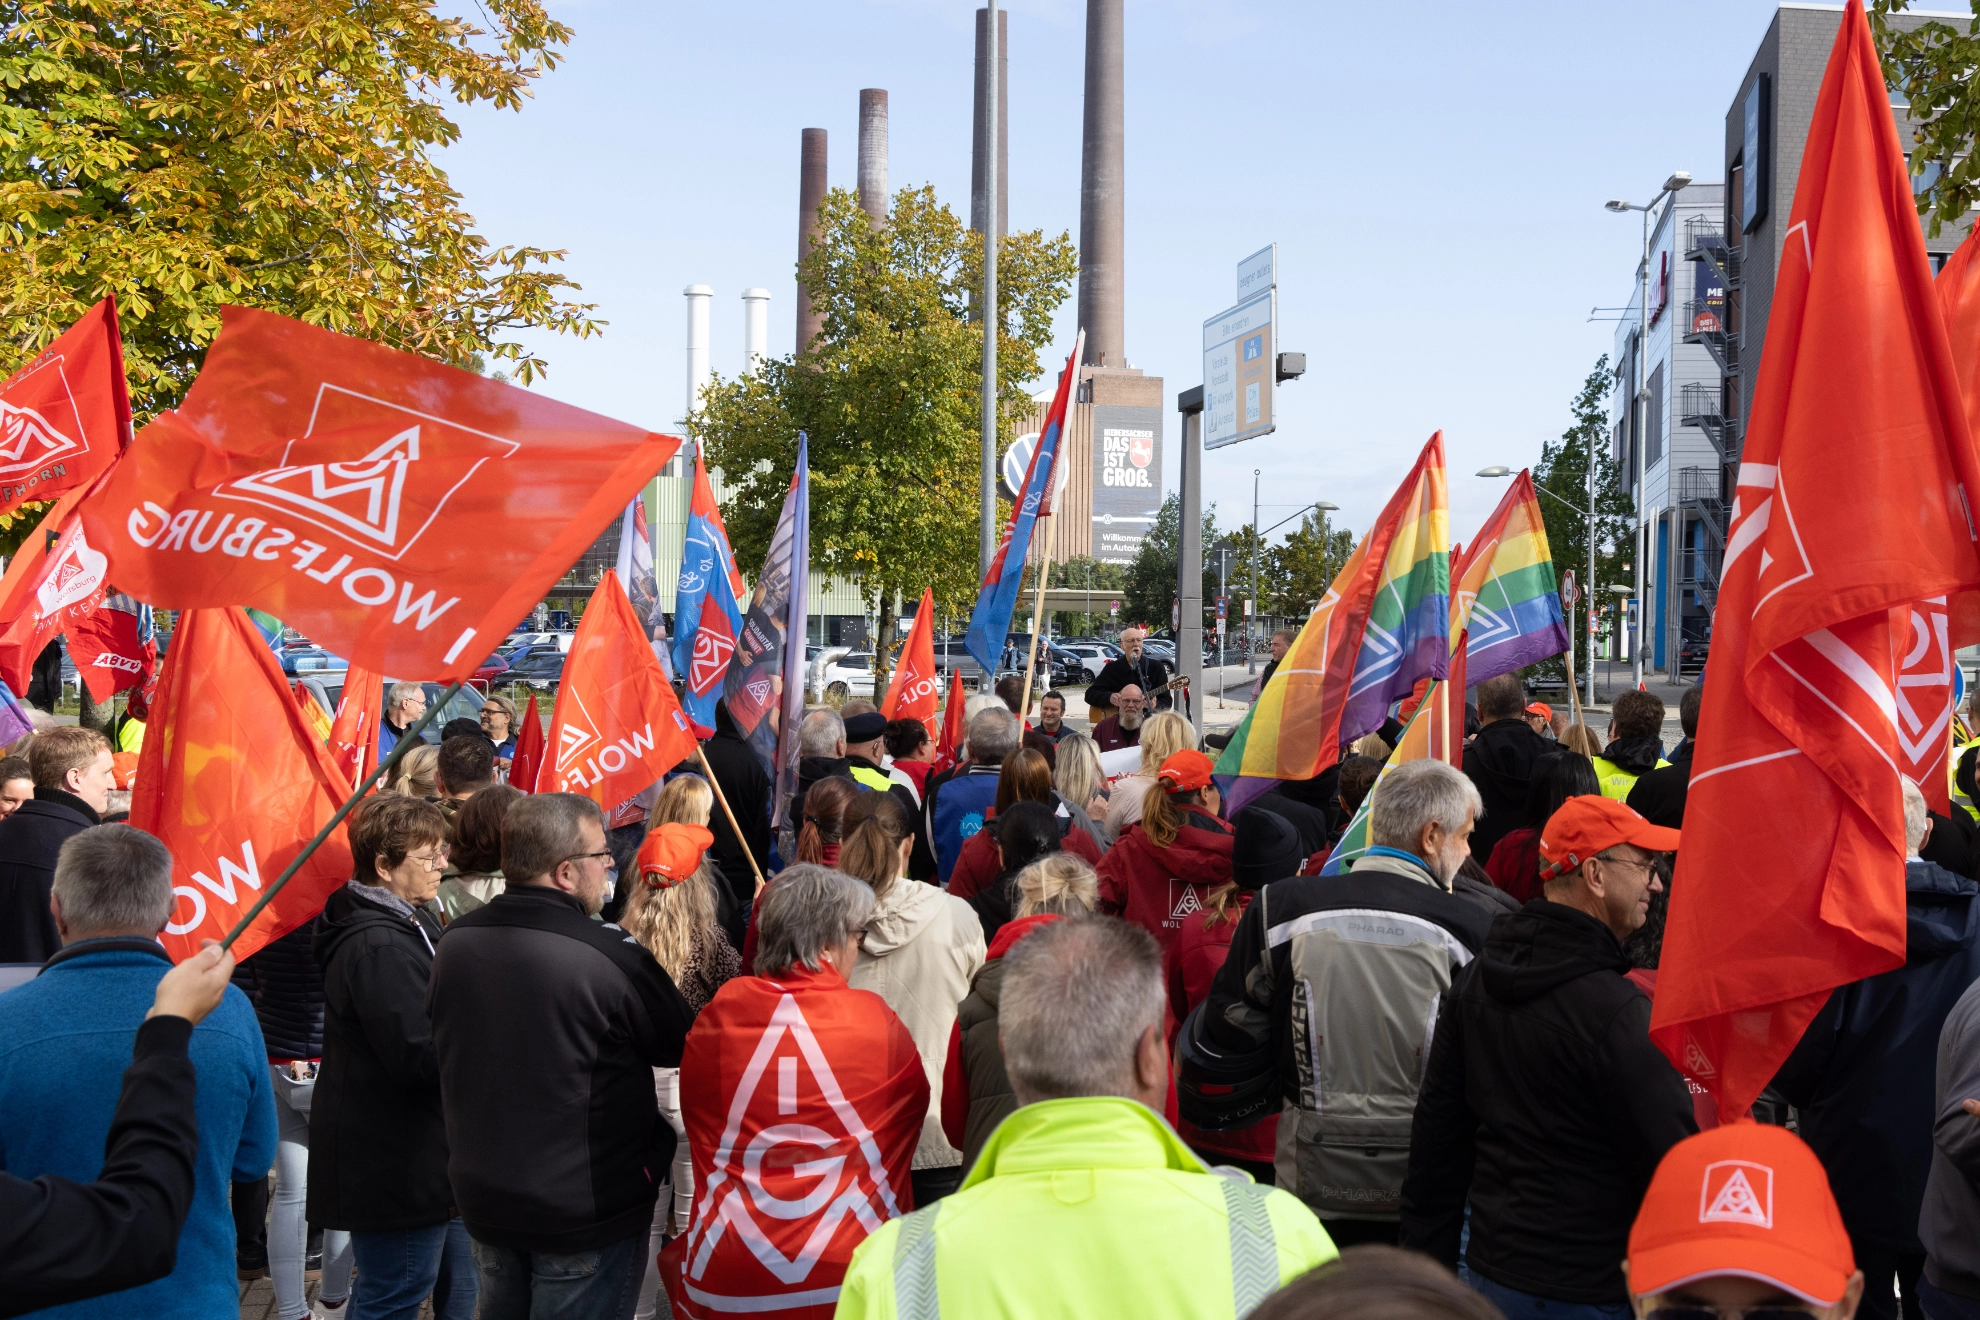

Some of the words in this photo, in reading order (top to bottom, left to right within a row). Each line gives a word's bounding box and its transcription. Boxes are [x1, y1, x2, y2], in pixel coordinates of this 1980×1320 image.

[1707, 288, 1723, 296] ME
[0, 348, 55, 395] EZIRK
[1103, 428, 1153, 438] NIEDERSACHSEN
[1103, 436, 1130, 453] DAS
[1103, 451, 1126, 468] IST
[0, 463, 67, 503] FHORN
[1101, 542, 1112, 551] im
[744, 628, 762, 653] GEWINNT
[748, 618, 774, 652] SOLIDARITÄT
[1162, 920, 1181, 929] WOL
[1348, 923, 1405, 936] PHARAO
[1687, 1083, 1709, 1094] LFS
[1322, 1185, 1401, 1202] PHARA
